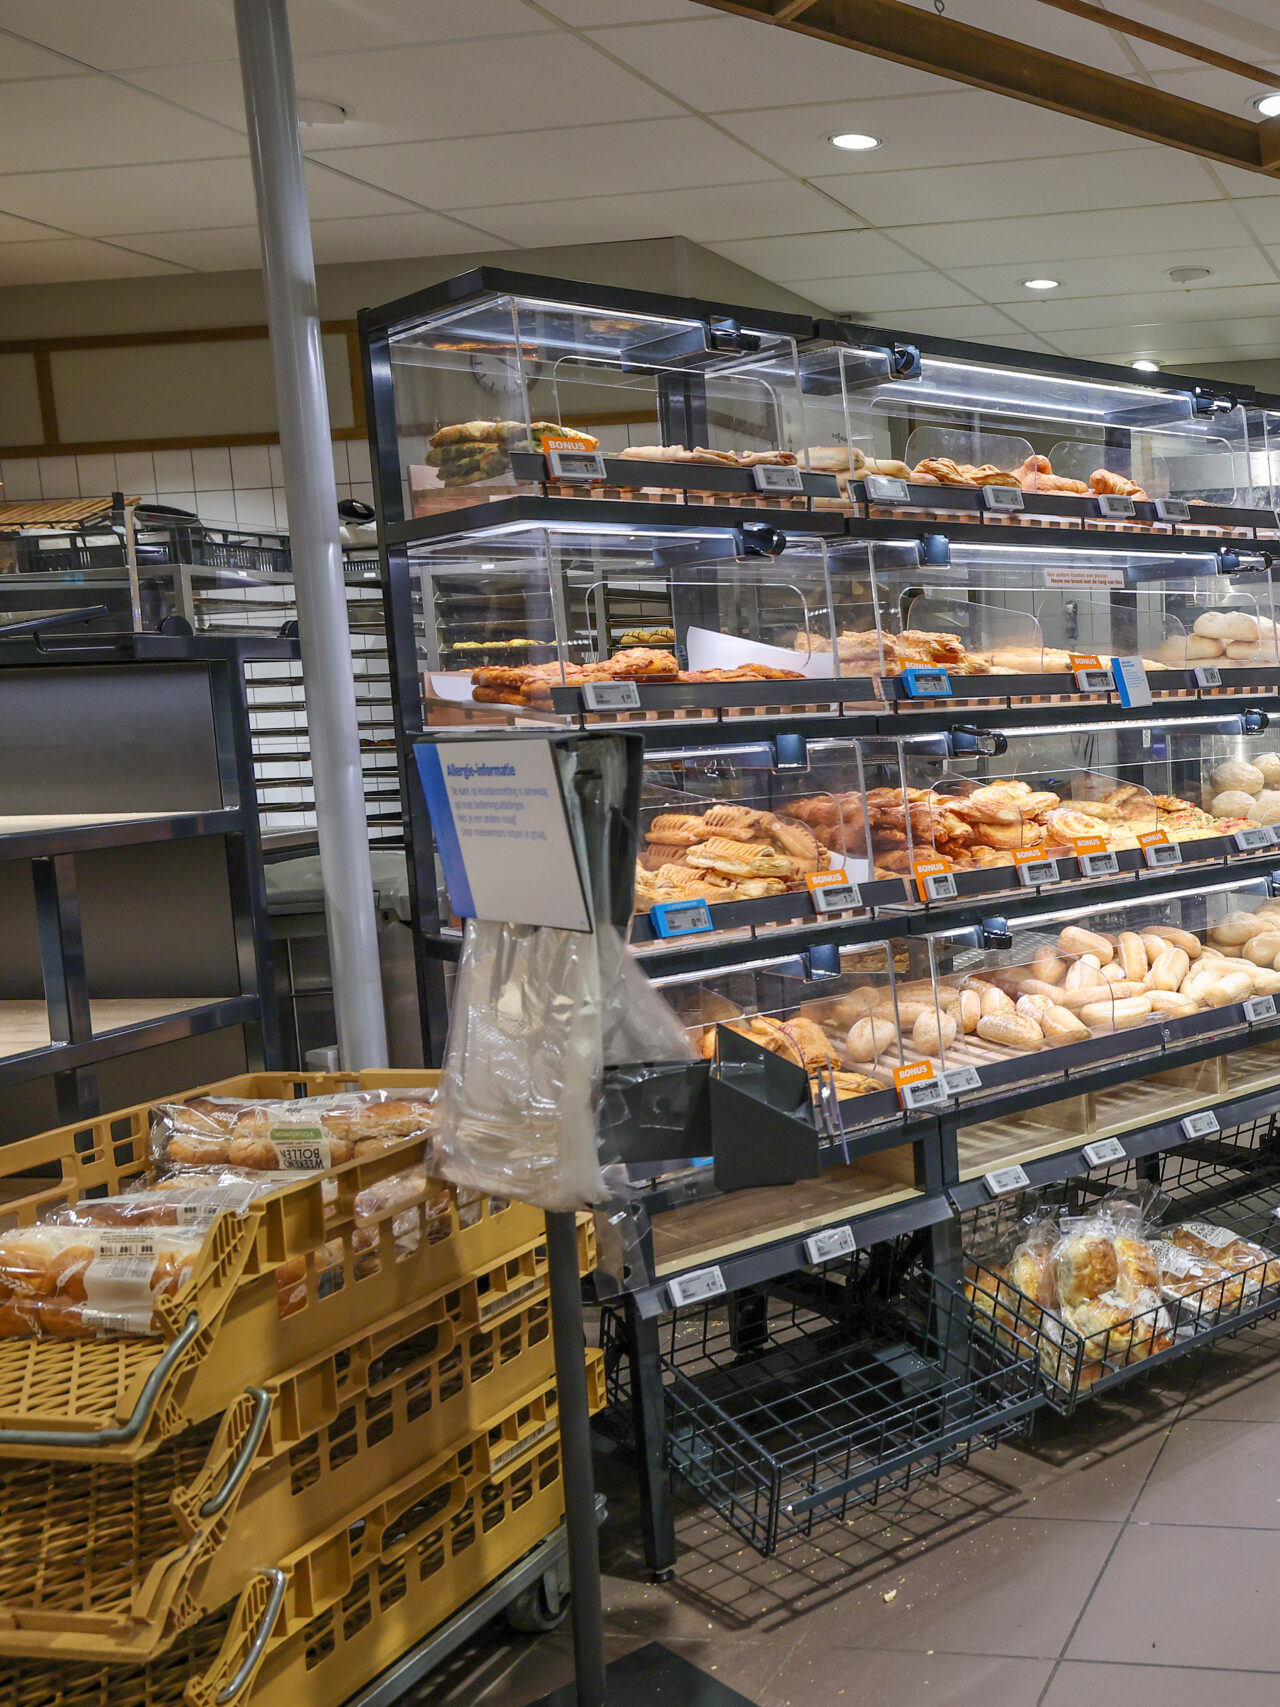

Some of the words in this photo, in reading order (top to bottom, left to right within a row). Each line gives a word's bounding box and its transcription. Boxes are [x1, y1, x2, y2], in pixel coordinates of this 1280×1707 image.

[548, 440, 586, 450] BONUS
[446, 762, 517, 780] Allergie-informatie
[1077, 838, 1101, 847] BONUS
[1141, 832, 1164, 844] BONUS
[1016, 848, 1041, 859] BONUS
[916, 862, 945, 873] BONUS
[811, 873, 843, 885] BONUS
[899, 1064, 928, 1079] BONUS
[280, 1148, 320, 1160] BOLLEN
